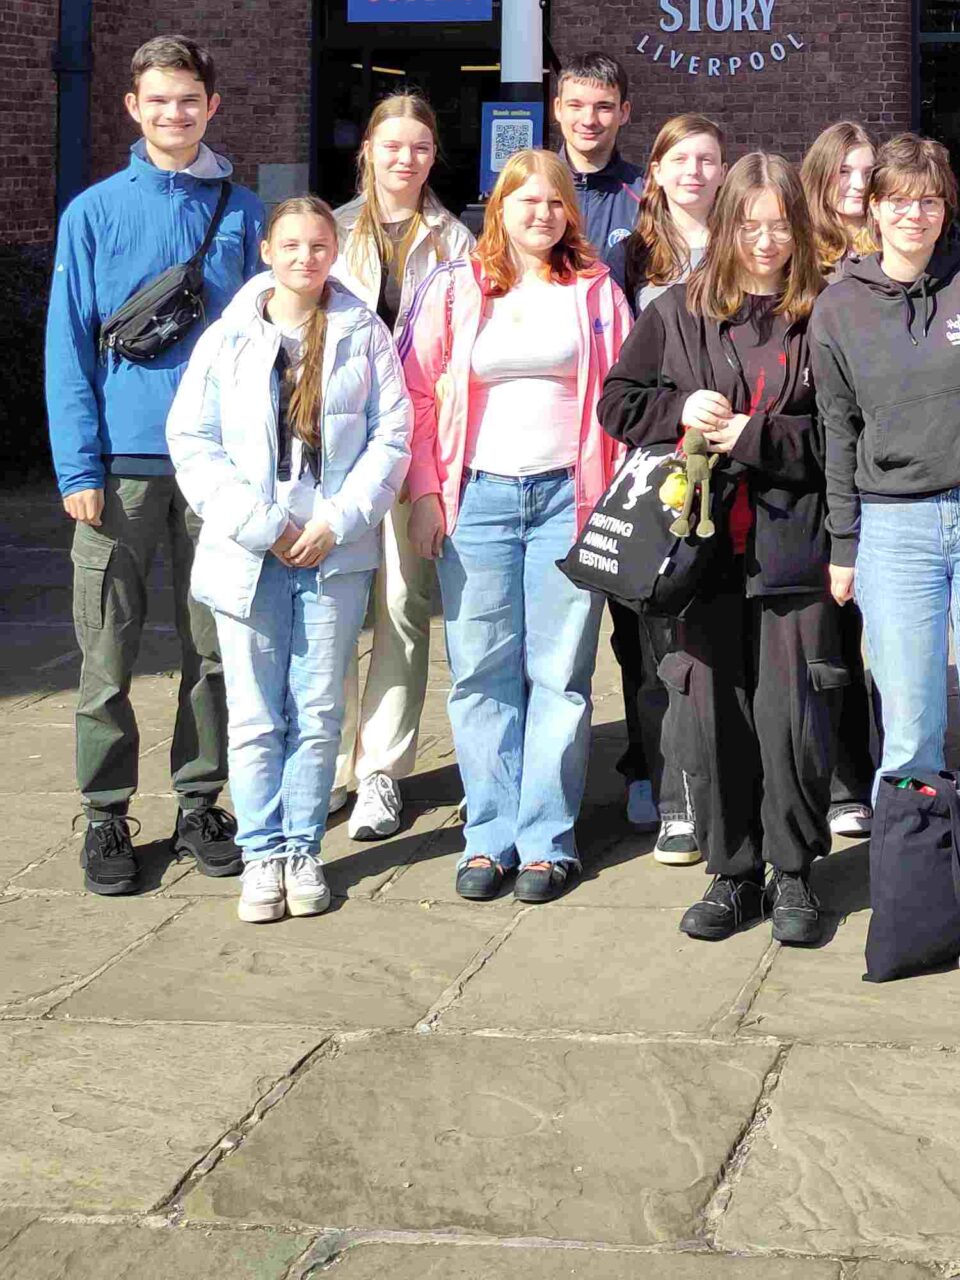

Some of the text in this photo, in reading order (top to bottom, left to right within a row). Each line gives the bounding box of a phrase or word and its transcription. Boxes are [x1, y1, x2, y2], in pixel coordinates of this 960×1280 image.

[636, 33, 805, 76] LIVERPOOL
[589, 512, 633, 537] FIGHTING
[582, 530, 619, 555] ANIMAL
[579, 549, 618, 574] TESTING
